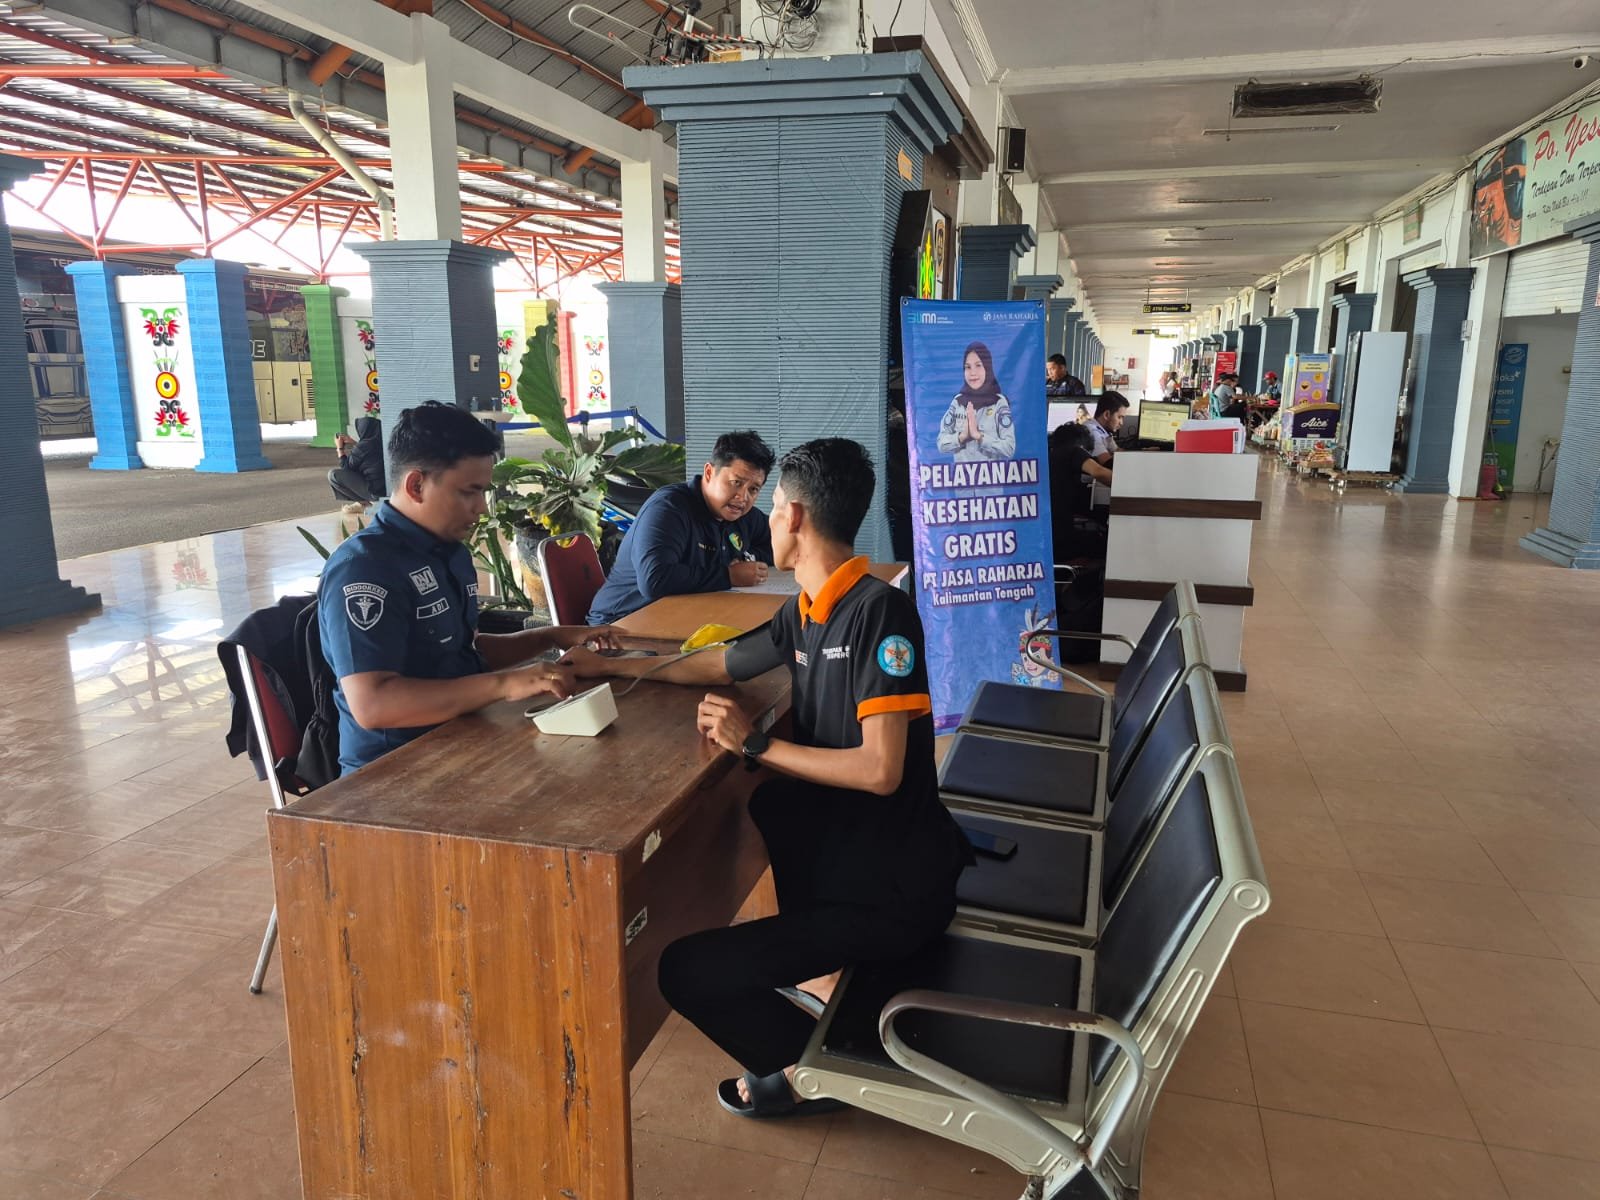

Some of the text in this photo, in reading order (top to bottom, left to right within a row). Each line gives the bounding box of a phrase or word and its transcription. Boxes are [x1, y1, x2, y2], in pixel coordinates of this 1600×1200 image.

[1300, 417, 1328, 428] Aice
[920, 460, 1038, 489] PELAYANAN
[923, 495, 1037, 524] KESEHATAN
[944, 531, 1016, 559] GRATIS
[941, 568, 974, 588] JASA
[978, 562, 1044, 585] RAHARJA
[933, 583, 1034, 606] Kalimantan Tengah
[431, 603, 446, 615] ADI
